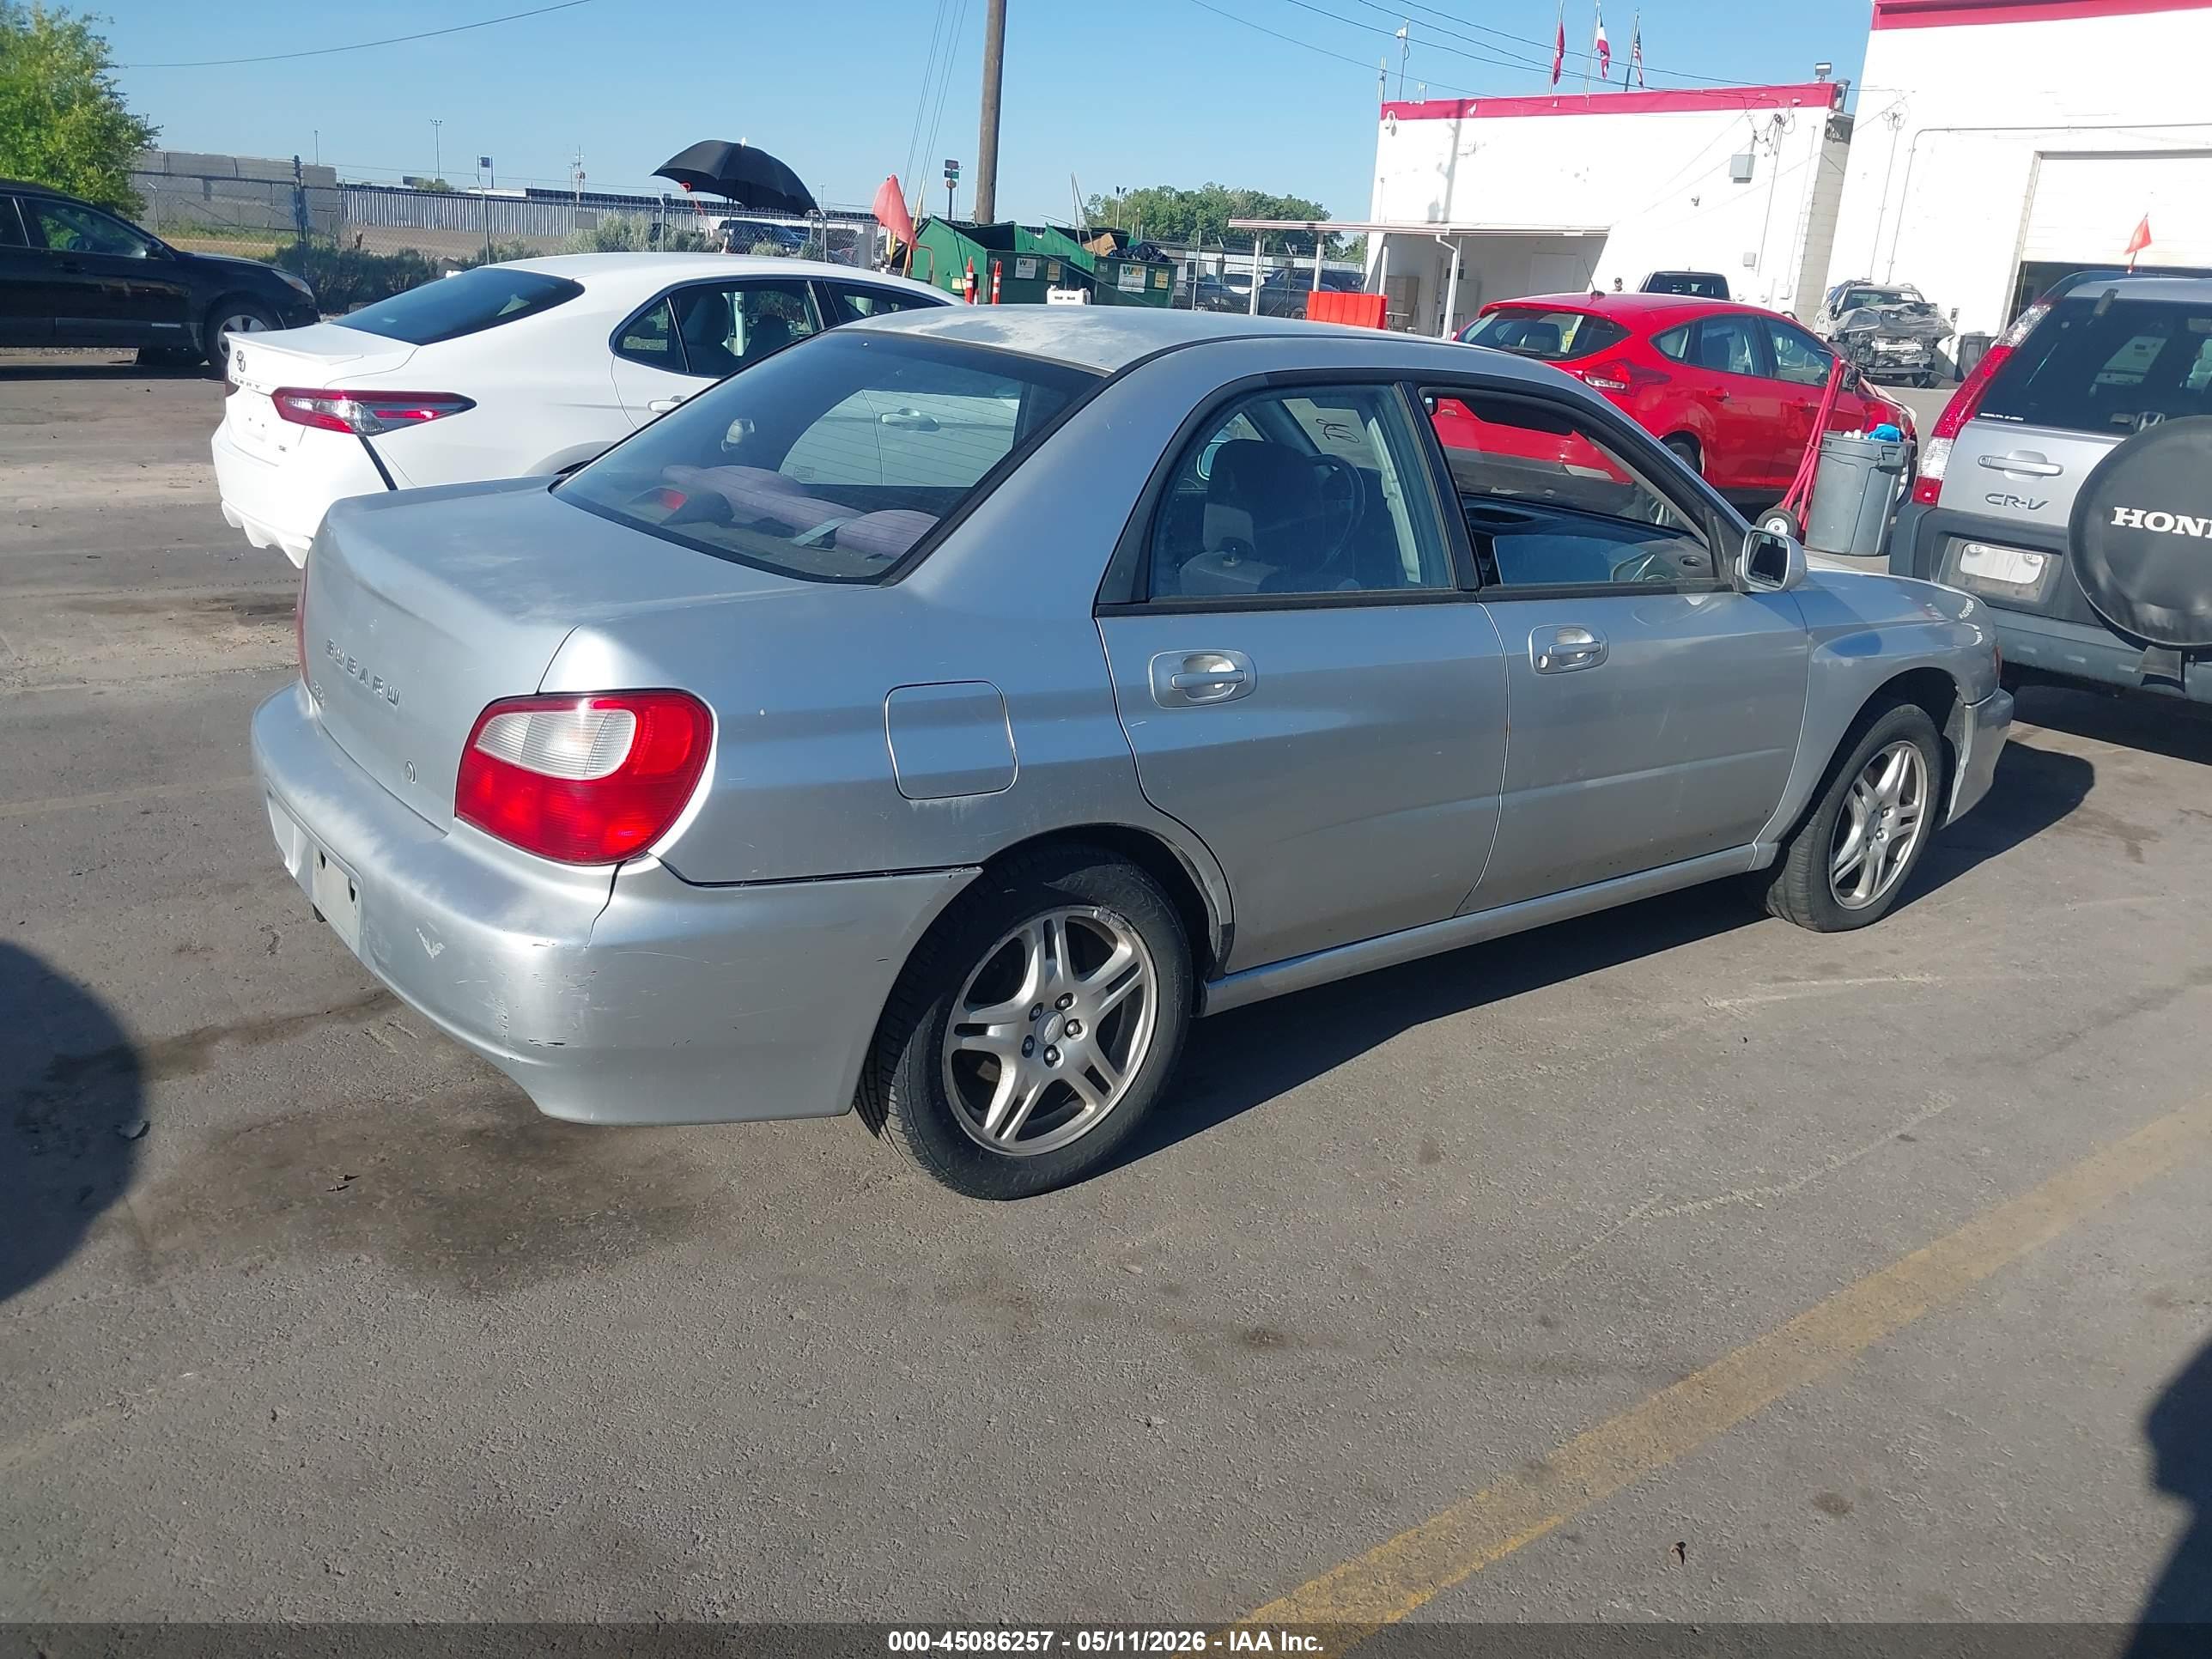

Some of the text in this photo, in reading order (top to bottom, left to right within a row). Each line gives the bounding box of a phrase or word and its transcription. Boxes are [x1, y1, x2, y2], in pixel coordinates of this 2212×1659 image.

[1985, 493, 2050, 510] CR-V
[2110, 506, 2212, 539] HON
[325, 638, 401, 707] SUBARU
